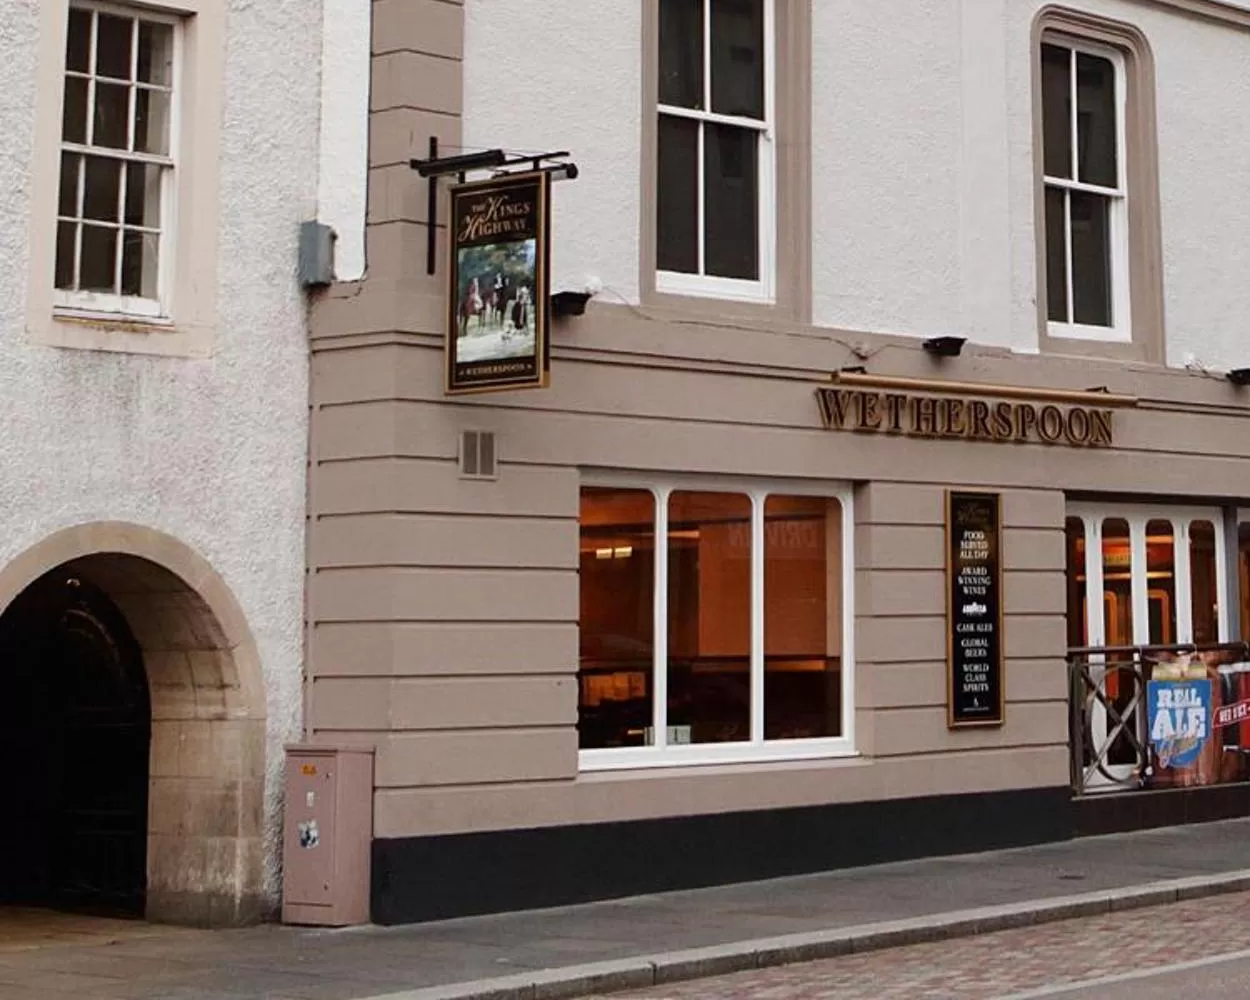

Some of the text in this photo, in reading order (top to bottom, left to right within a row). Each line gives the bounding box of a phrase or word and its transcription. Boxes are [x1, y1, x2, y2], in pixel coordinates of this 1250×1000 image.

[486, 195, 531, 221] KINGS
[458, 215, 526, 242] HIGHWAY
[815, 387, 1114, 446] WETHERSPOON
[1157, 688, 1202, 708] REAL
[1152, 707, 1205, 740] ALE
